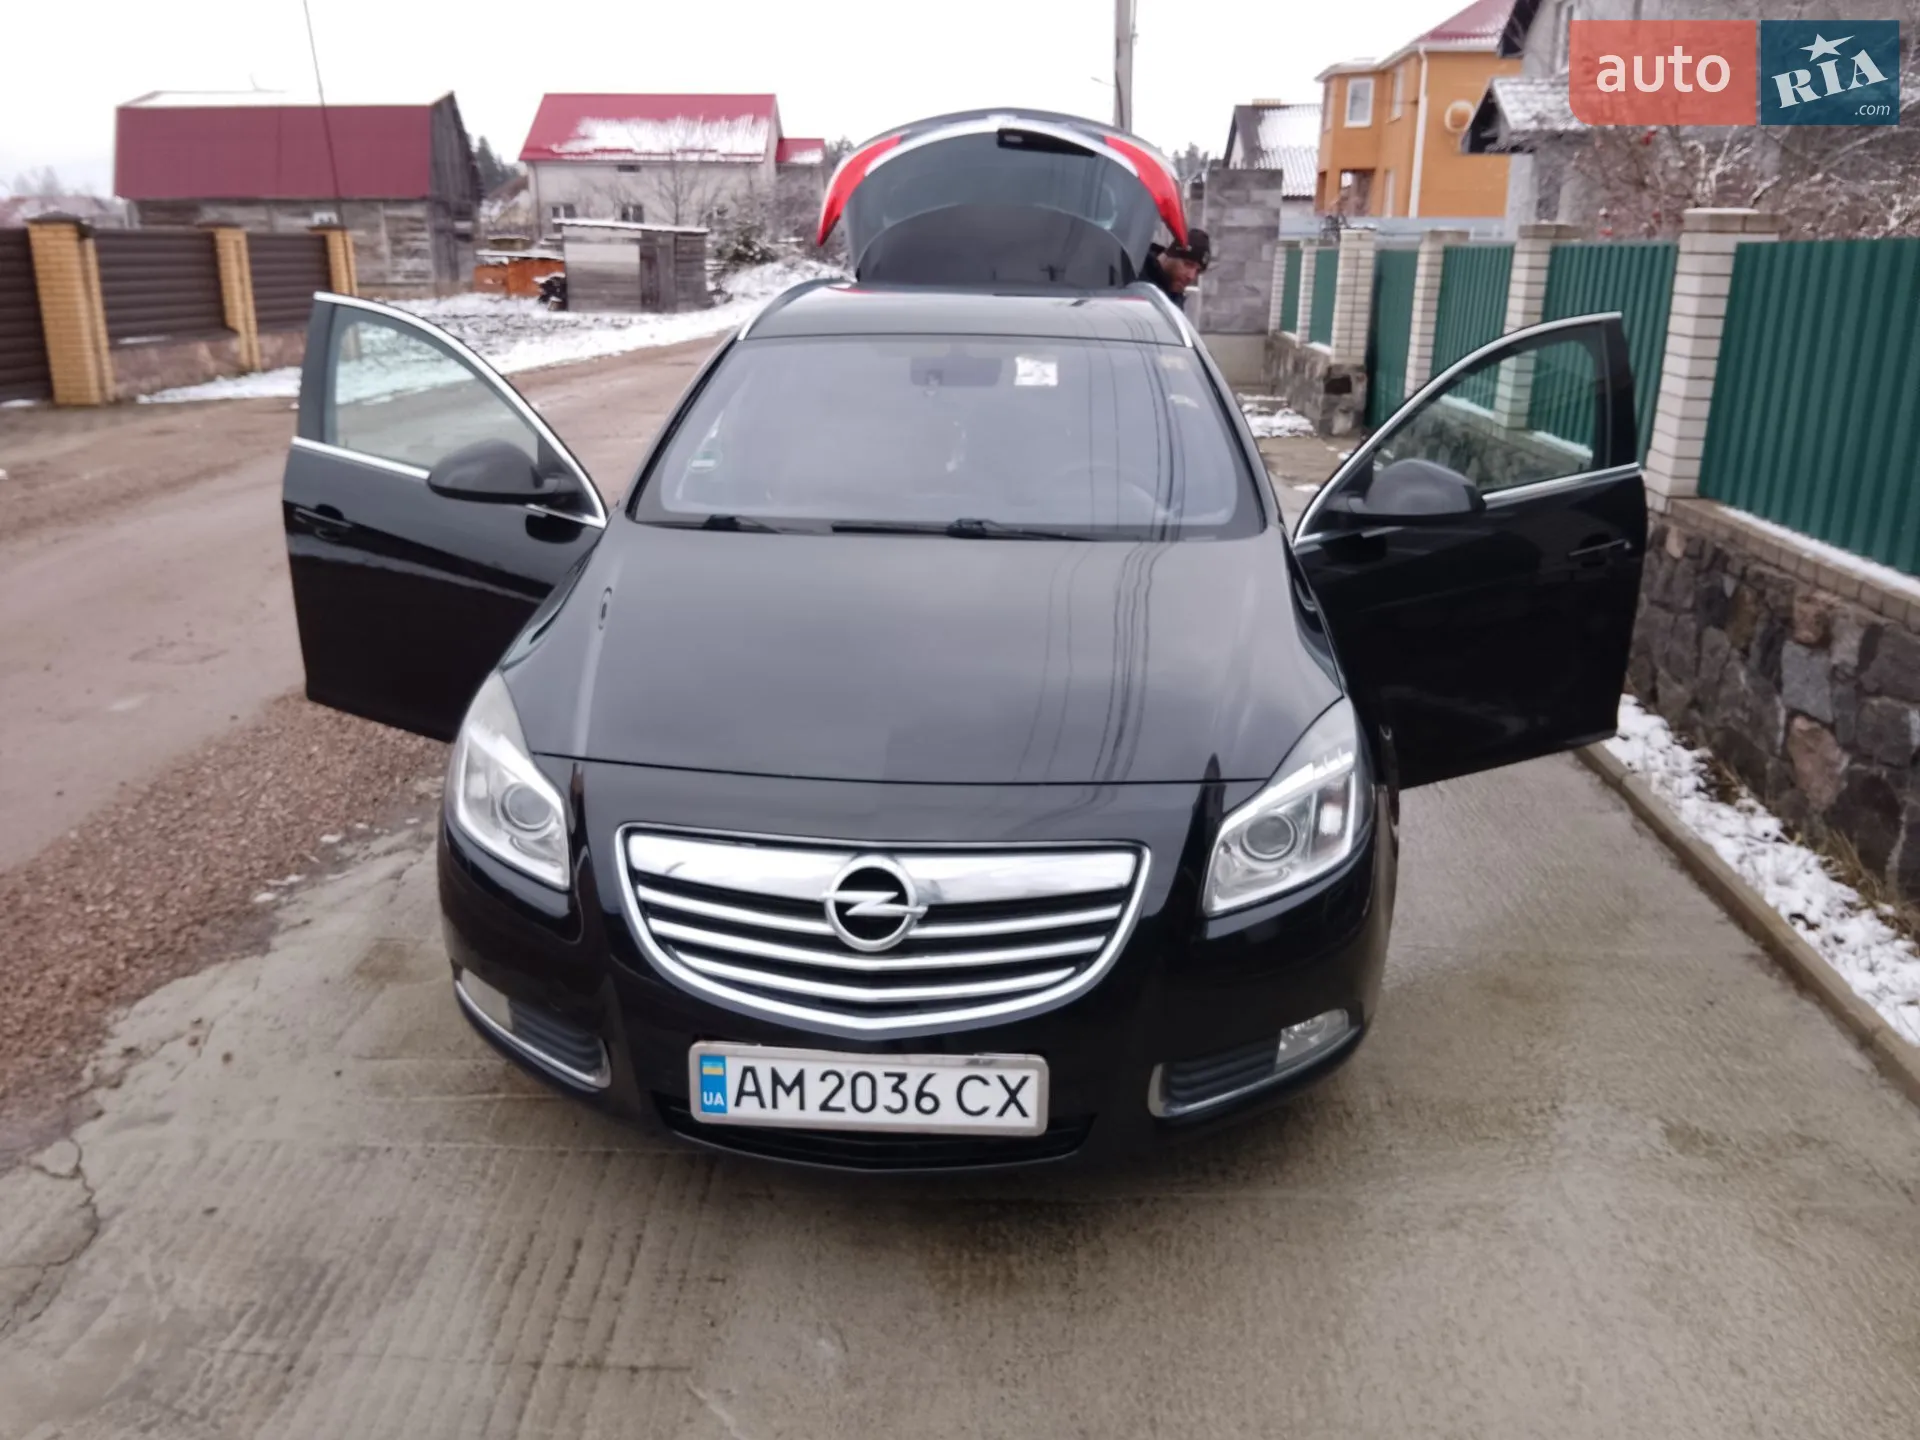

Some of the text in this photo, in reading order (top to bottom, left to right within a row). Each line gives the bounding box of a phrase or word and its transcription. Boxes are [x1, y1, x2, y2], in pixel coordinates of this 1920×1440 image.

[703, 1091, 725, 1106] UA
[734, 1065, 1030, 1118] AM 2036 CX
